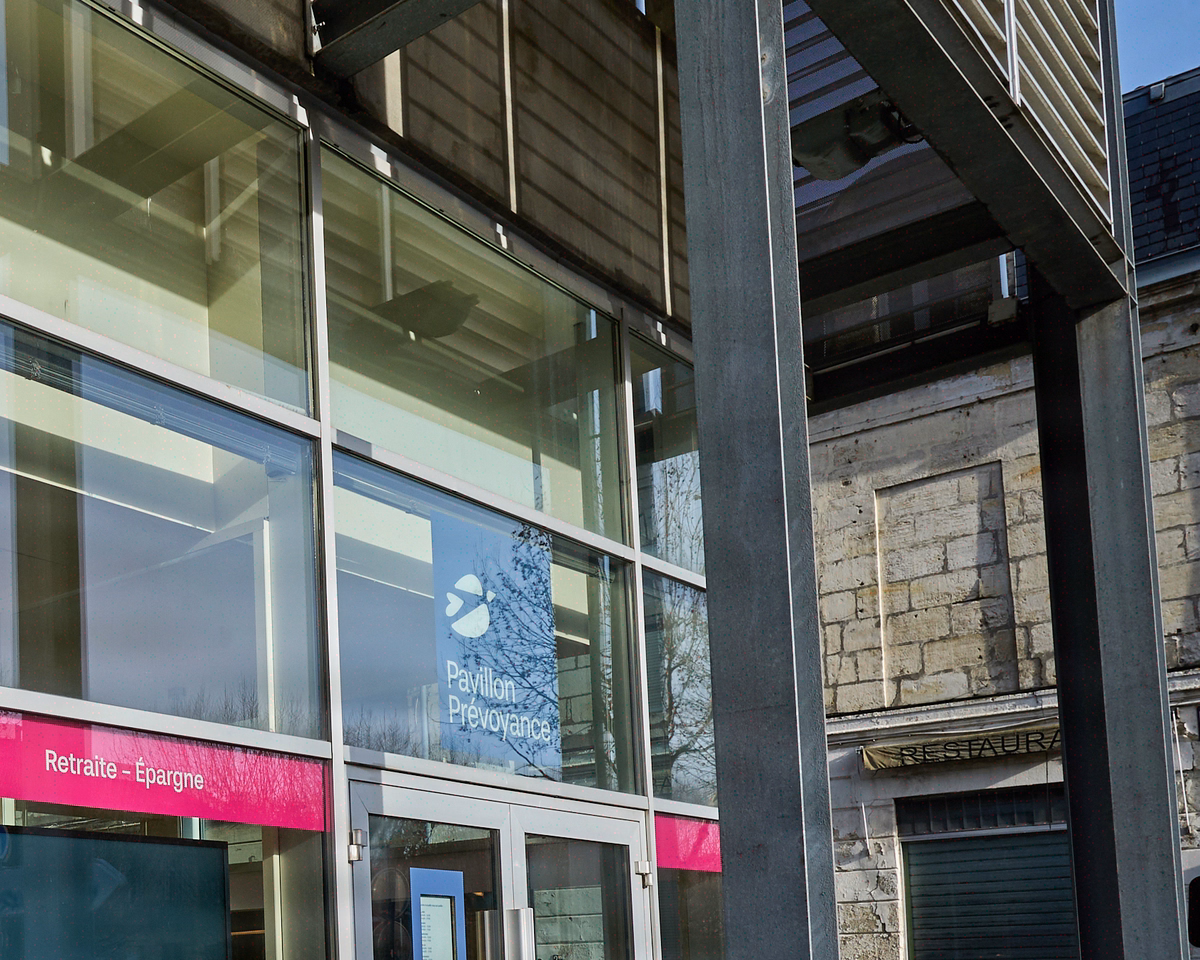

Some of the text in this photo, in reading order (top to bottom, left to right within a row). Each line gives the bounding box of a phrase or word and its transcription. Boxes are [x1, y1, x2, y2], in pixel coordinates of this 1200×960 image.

[446, 660, 516, 703] Pavillon
[448, 694, 552, 742] Prévoyance
[45, 749, 117, 780] Retraite
[135, 757, 204, 793] Épargne
